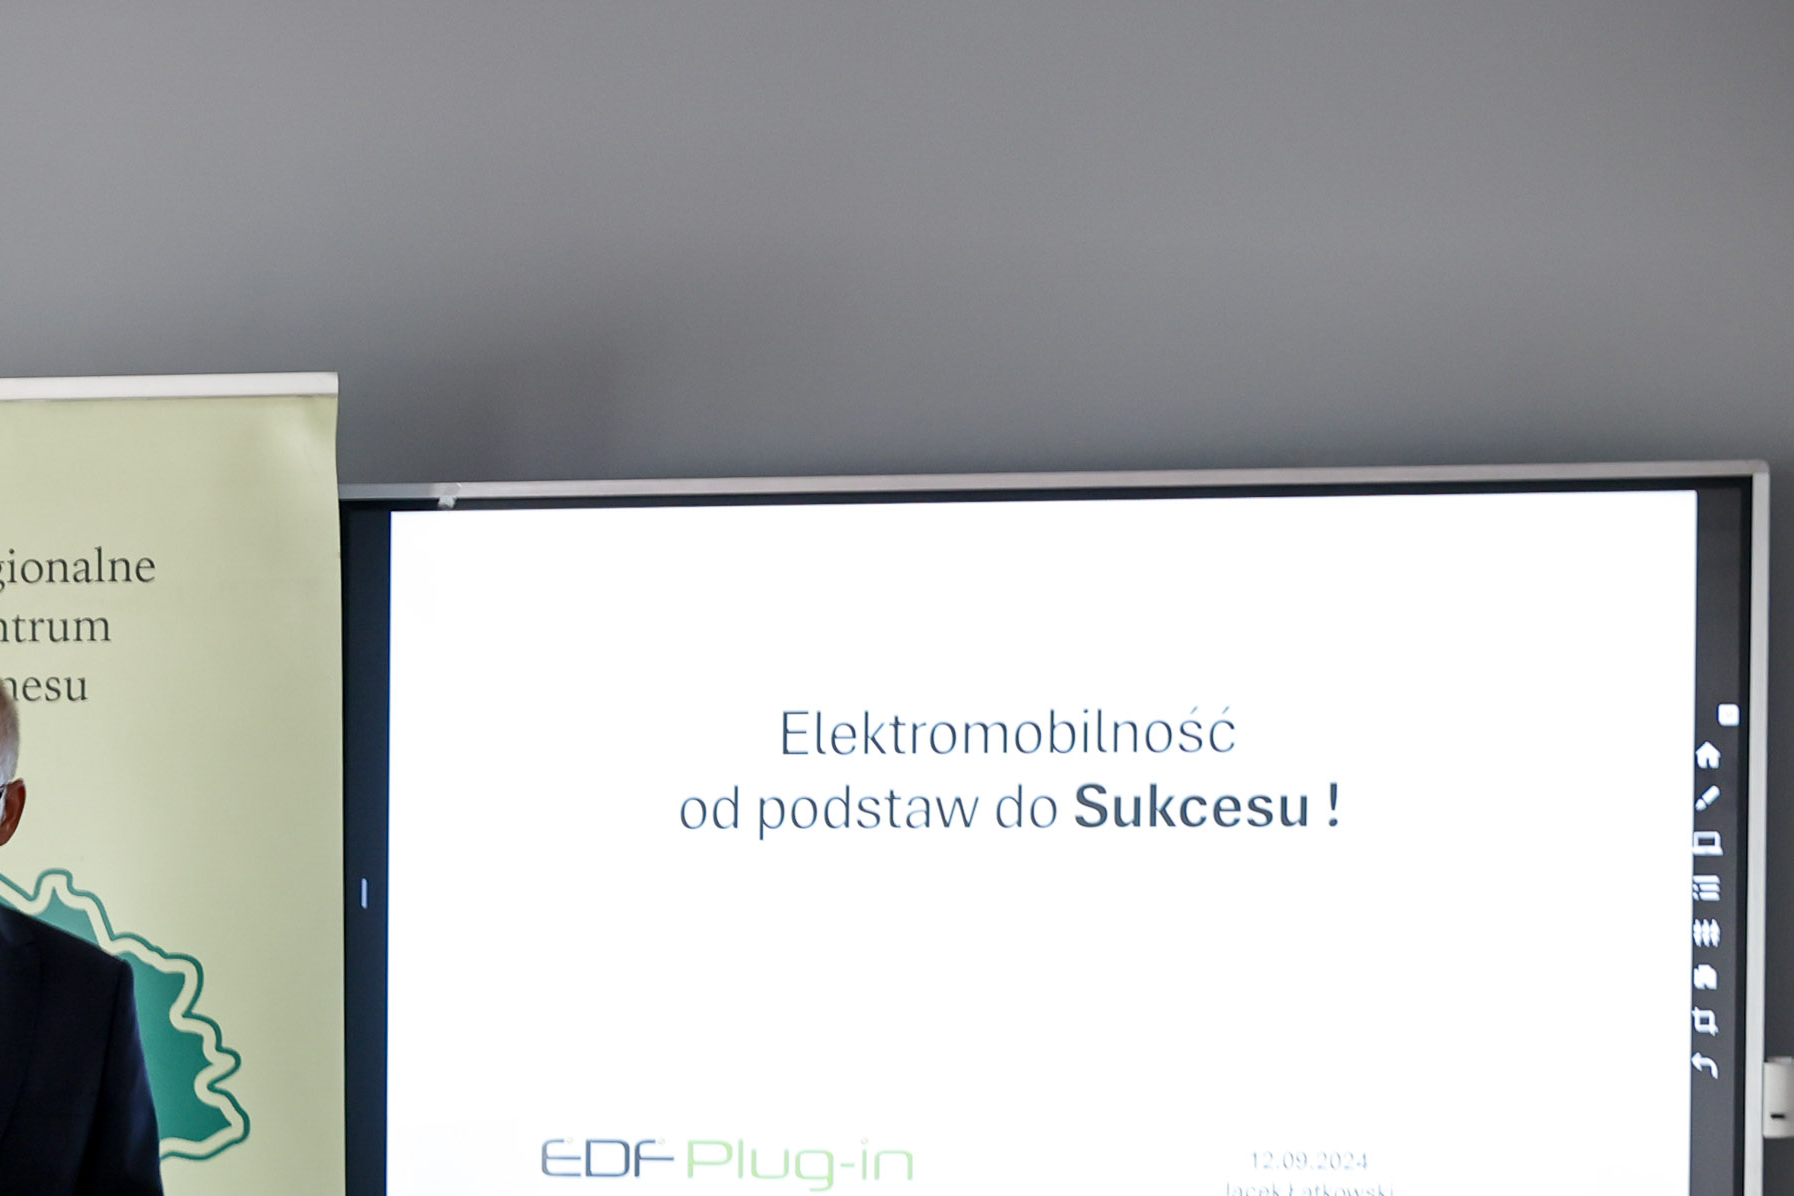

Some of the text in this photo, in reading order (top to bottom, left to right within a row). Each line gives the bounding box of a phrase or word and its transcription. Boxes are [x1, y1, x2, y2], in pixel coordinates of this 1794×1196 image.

[783, 707, 1235, 755] Elektromobilność
[681, 785, 738, 829] od
[760, 785, 979, 840] podstaw
[996, 784, 1057, 828] do
[1075, 783, 1307, 828] Sukcesu
[542, 1138, 913, 1192] EDF Plug-in
[1251, 1150, 1368, 1171] 12.09.2024
